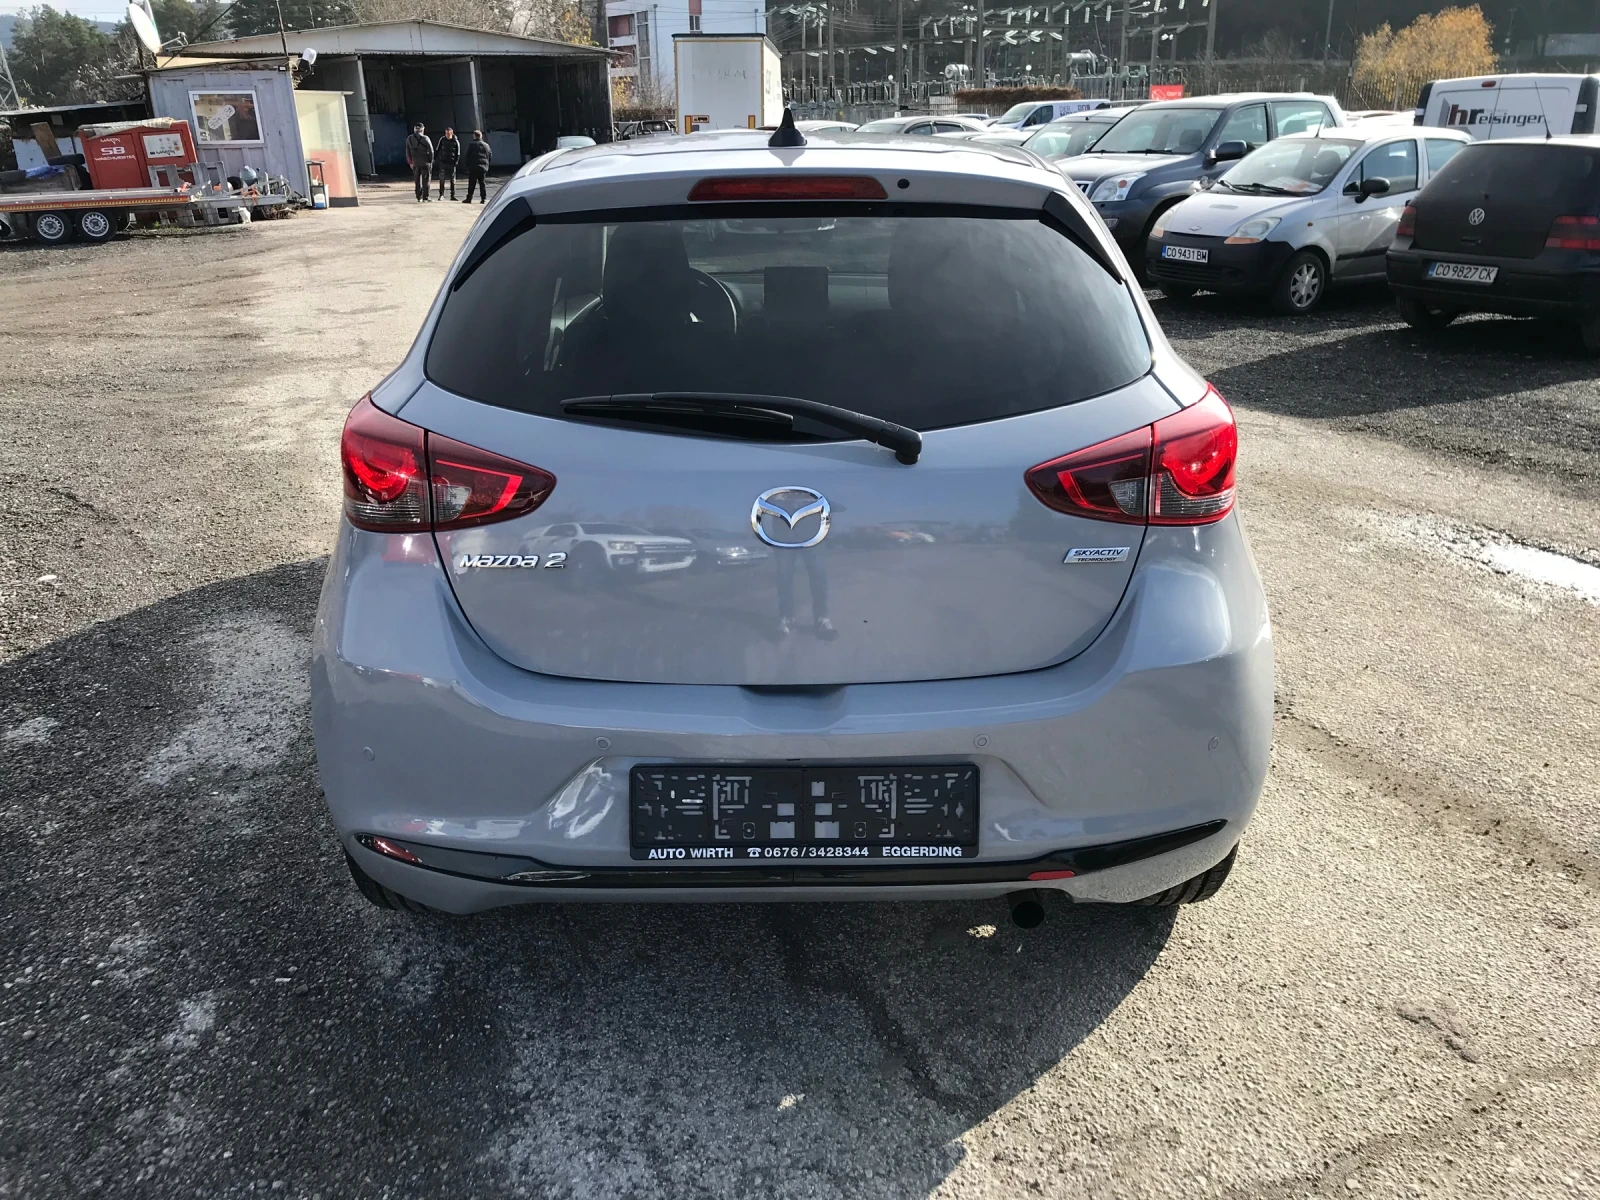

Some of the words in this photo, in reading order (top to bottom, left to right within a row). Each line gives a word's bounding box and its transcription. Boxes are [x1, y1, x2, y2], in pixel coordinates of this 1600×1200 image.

[101, 146, 126, 156] SB
[1166, 247, 1177, 258] CO
[1177, 248, 1195, 260] 9431
[1435, 264, 1451, 276] CO
[1452, 266, 1479, 279] 9827
[1479, 268, 1495, 281] CK
[1073, 549, 1124, 557] SKYACTIV
[543, 552, 568, 569] 2
[648, 848, 686, 859] AUTO
[690, 847, 734, 858] WIRTH
[882, 846, 962, 857] EGGERDING
